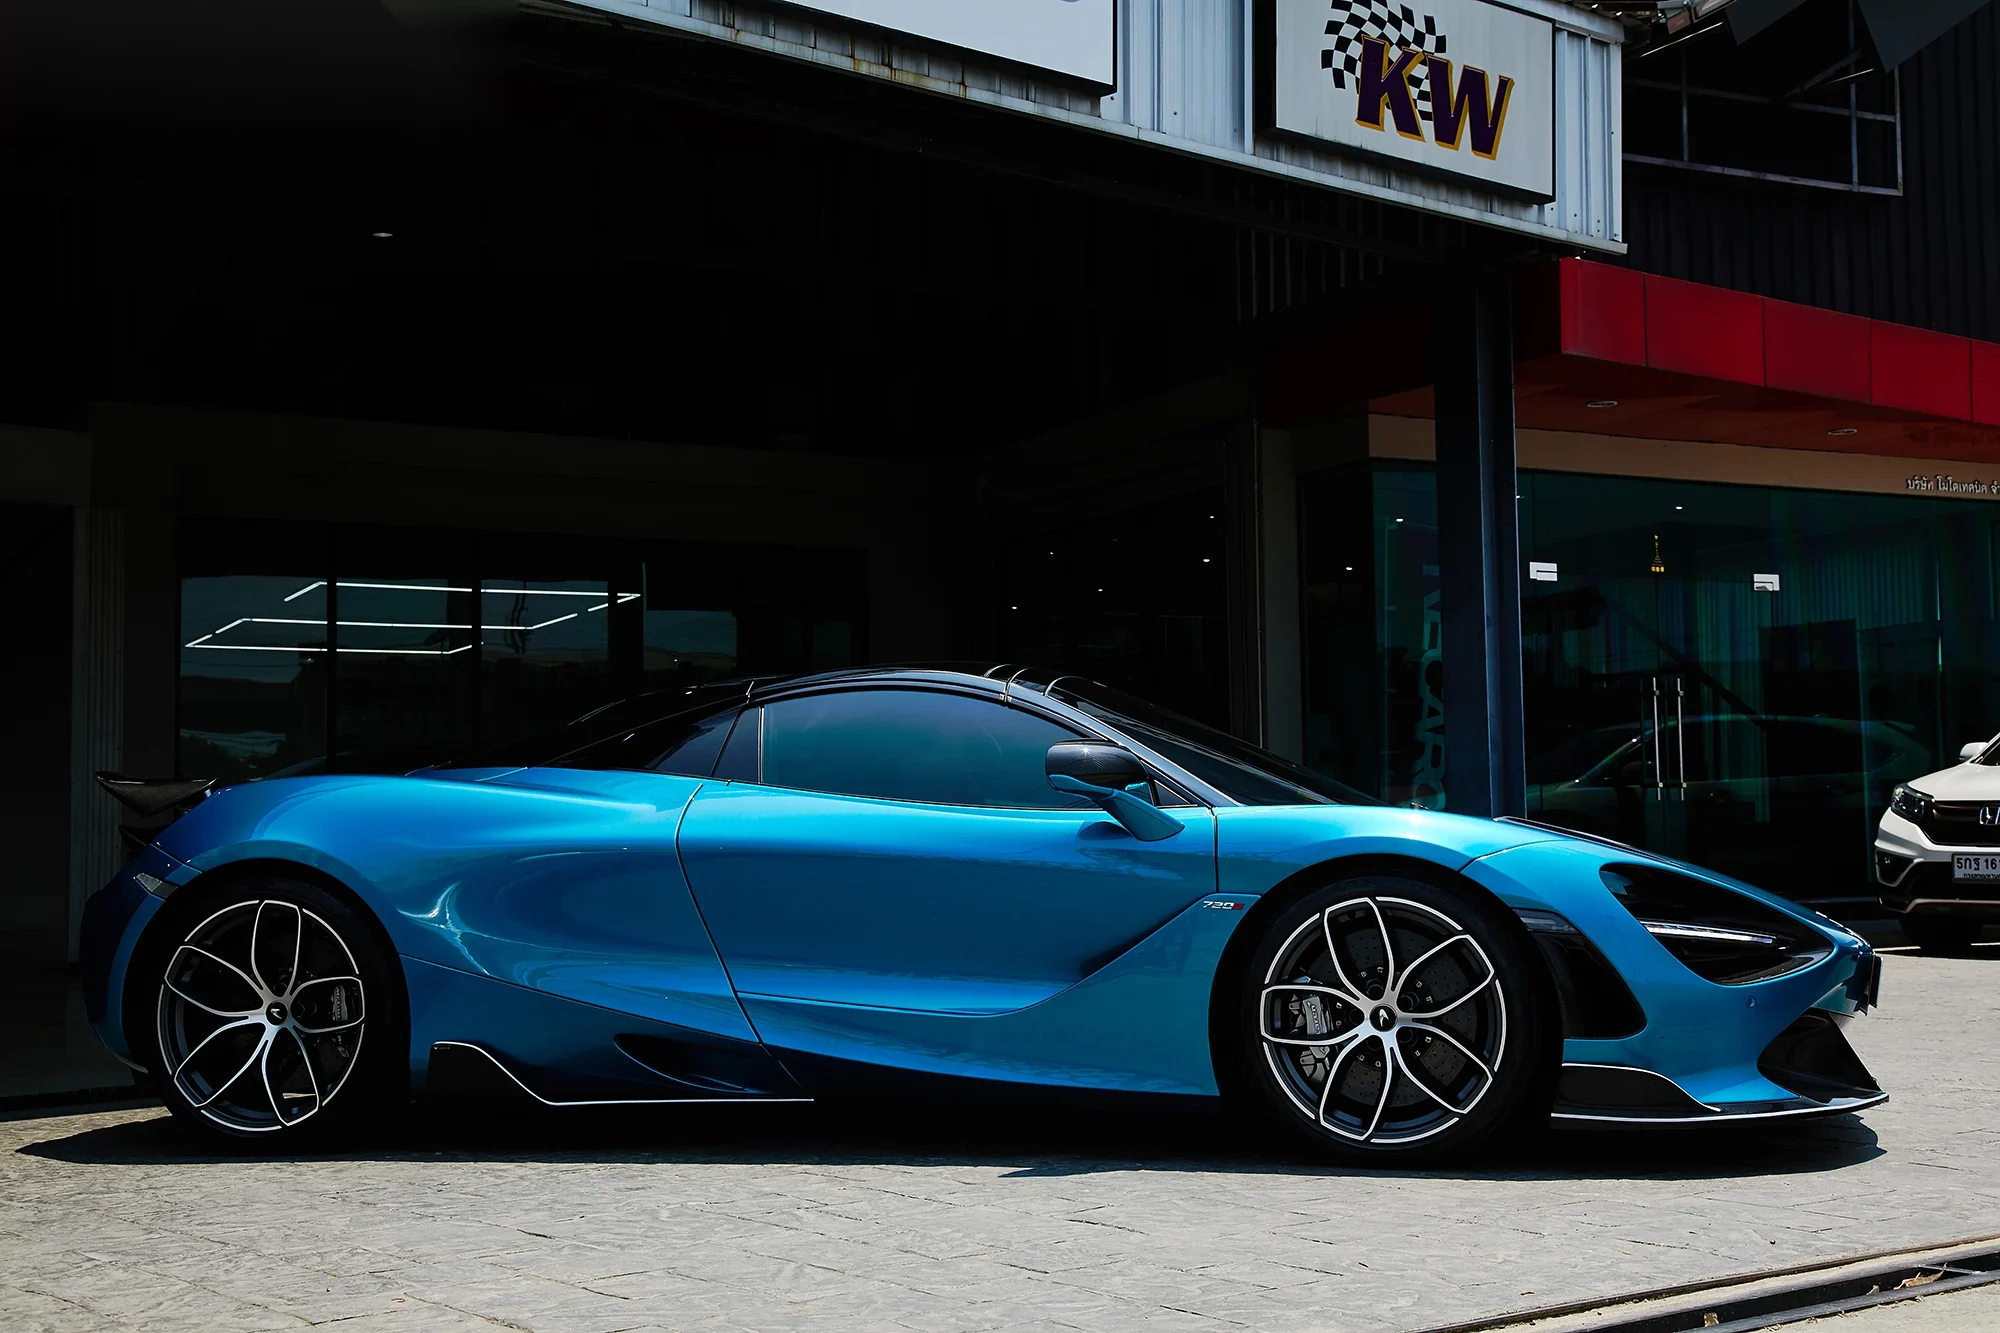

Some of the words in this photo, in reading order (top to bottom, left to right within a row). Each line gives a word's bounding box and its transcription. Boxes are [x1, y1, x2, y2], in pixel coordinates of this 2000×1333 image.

[1355, 33, 1515, 160] KW
[1907, 475, 1934, 490] บริษัท
[1985, 858, 2000, 870] 16
[1203, 900, 1245, 910] 720S
